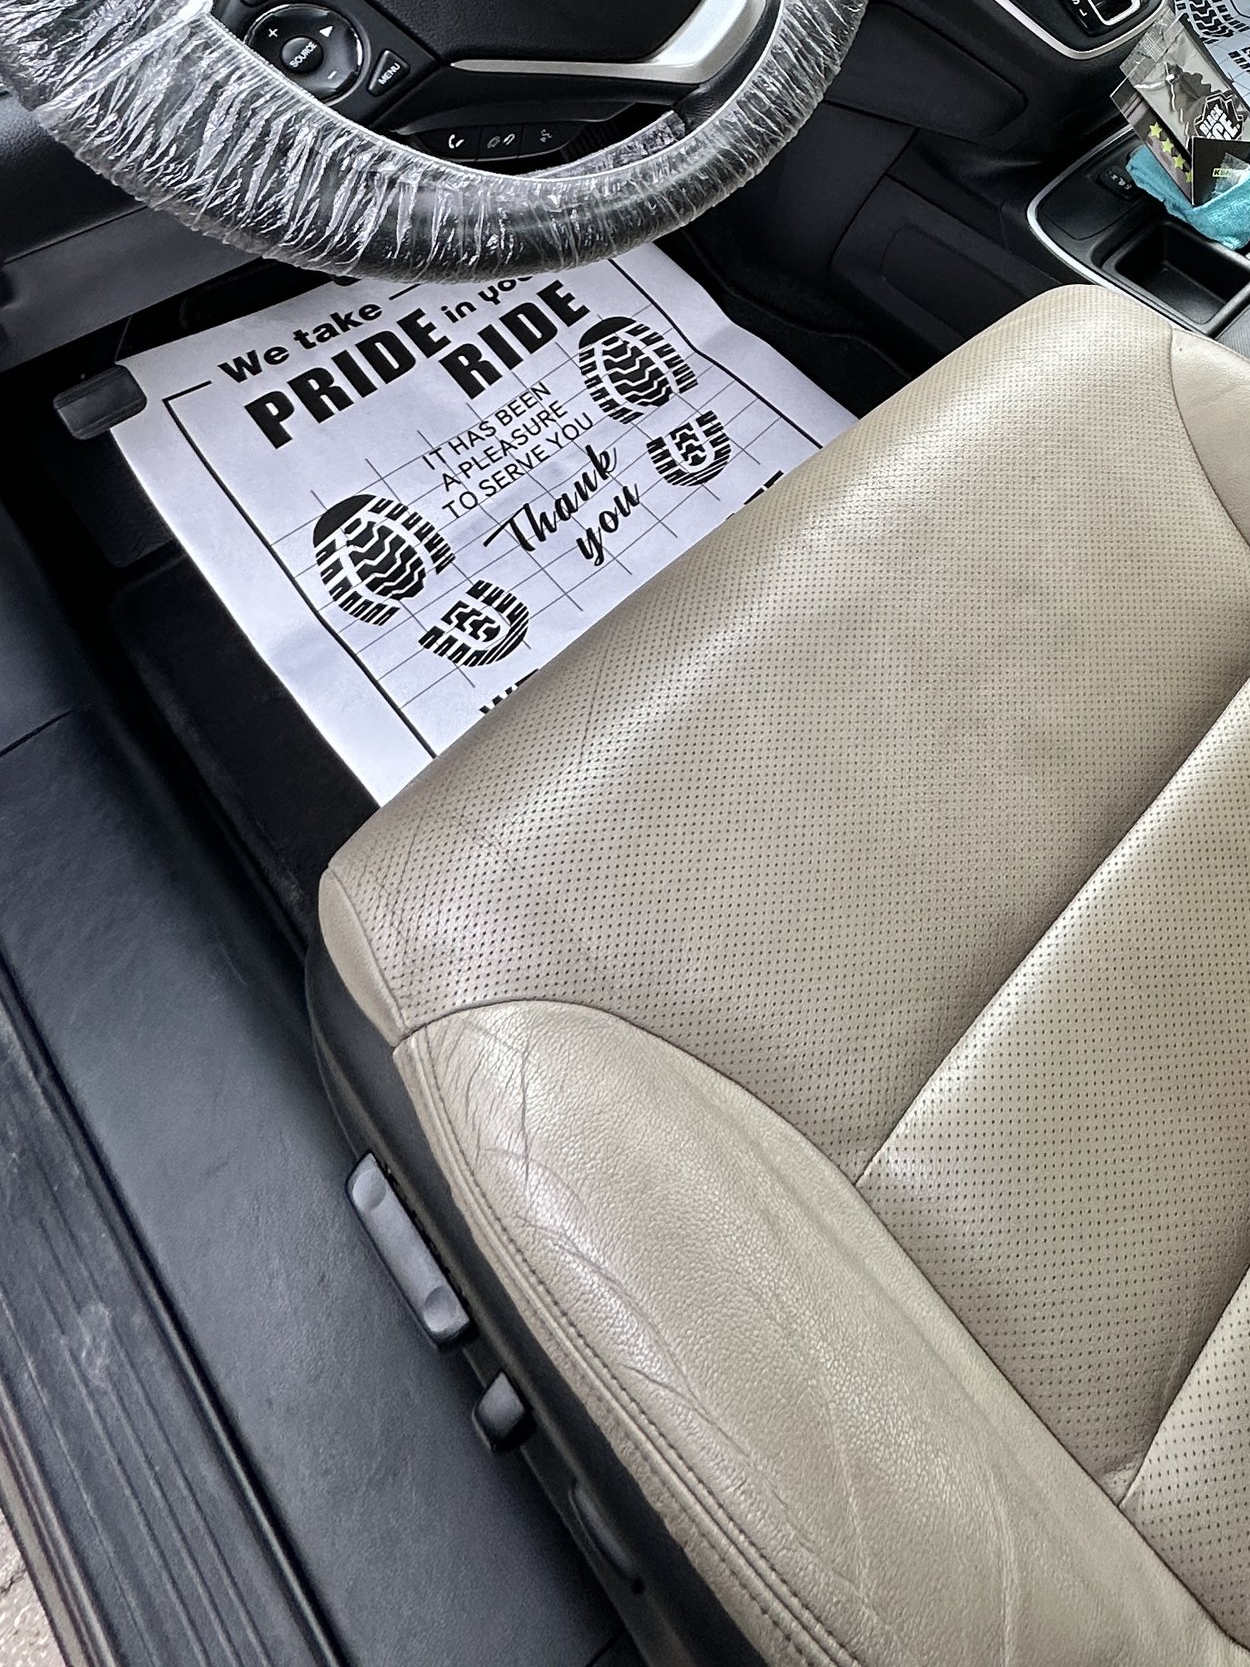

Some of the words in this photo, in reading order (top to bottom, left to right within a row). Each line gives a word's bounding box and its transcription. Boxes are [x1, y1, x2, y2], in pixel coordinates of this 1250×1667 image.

[289, 41, 318, 68] SOURCE
[1079, 9, 1087, 17] L
[378, 62, 401, 85] MENU
[1199, 103, 1223, 136] BLACK
[1206, 112, 1240, 140] CE.
[217, 345, 290, 384] We
[293, 303, 383, 351] take
[244, 307, 452, 450] PRIDE
[441, 301, 477, 323] in
[478, 276, 533, 305] yo
[438, 279, 591, 400] RIDE
[422, 447, 447, 470] IT
[448, 420, 497, 456] HAS
[495, 381, 551, 427] BEEN
[442, 473, 461, 492] A
[458, 400, 568, 479] PLEASURE
[442, 491, 479, 519] TO
[479, 444, 551, 498] SERVE
[545, 412, 594, 450] YOU
[483, 444, 617, 552] Thank
[576, 483, 640, 566] you
